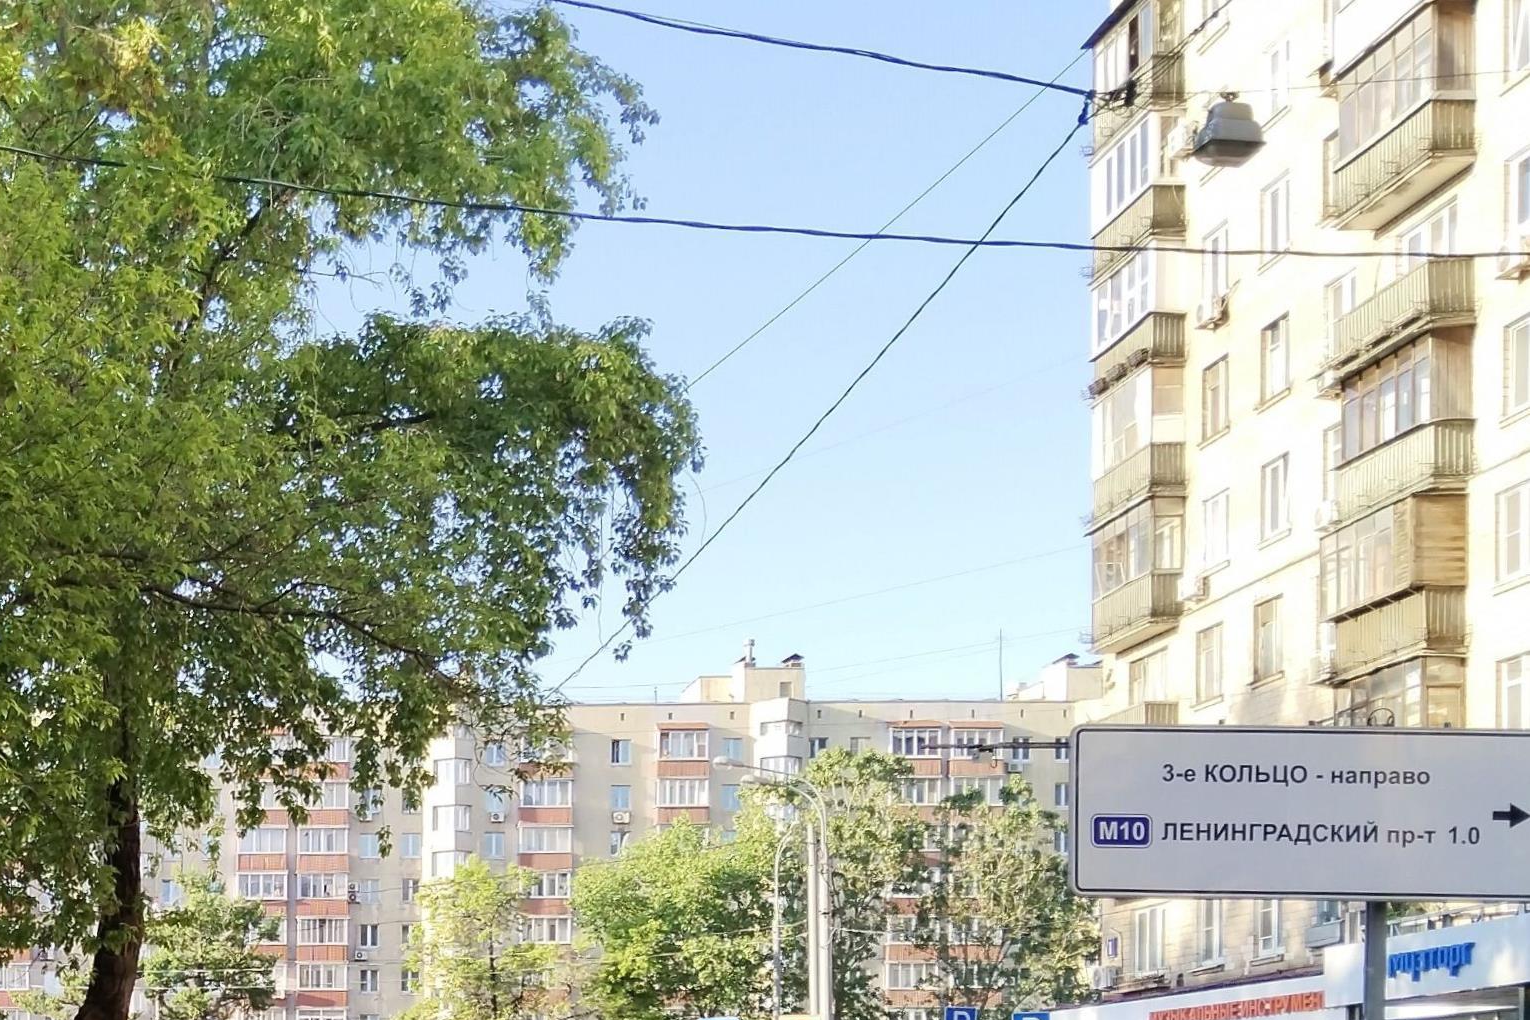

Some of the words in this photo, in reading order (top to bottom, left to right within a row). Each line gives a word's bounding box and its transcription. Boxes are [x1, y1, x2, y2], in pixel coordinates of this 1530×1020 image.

[1162, 764, 1196, 783] 3-е
[1204, 765, 1308, 787] КОЛЬЦО
[1330, 771, 1430, 787] направо
[1099, 822, 1145, 841] М10
[1162, 821, 1378, 844] ЛЕНИНГРАДСКИЙ
[1388, 829, 1435, 847] пр-т
[1449, 828, 1480, 844] 1.0
[1241, 990, 1324, 1017] ИНСТРУМЕН
